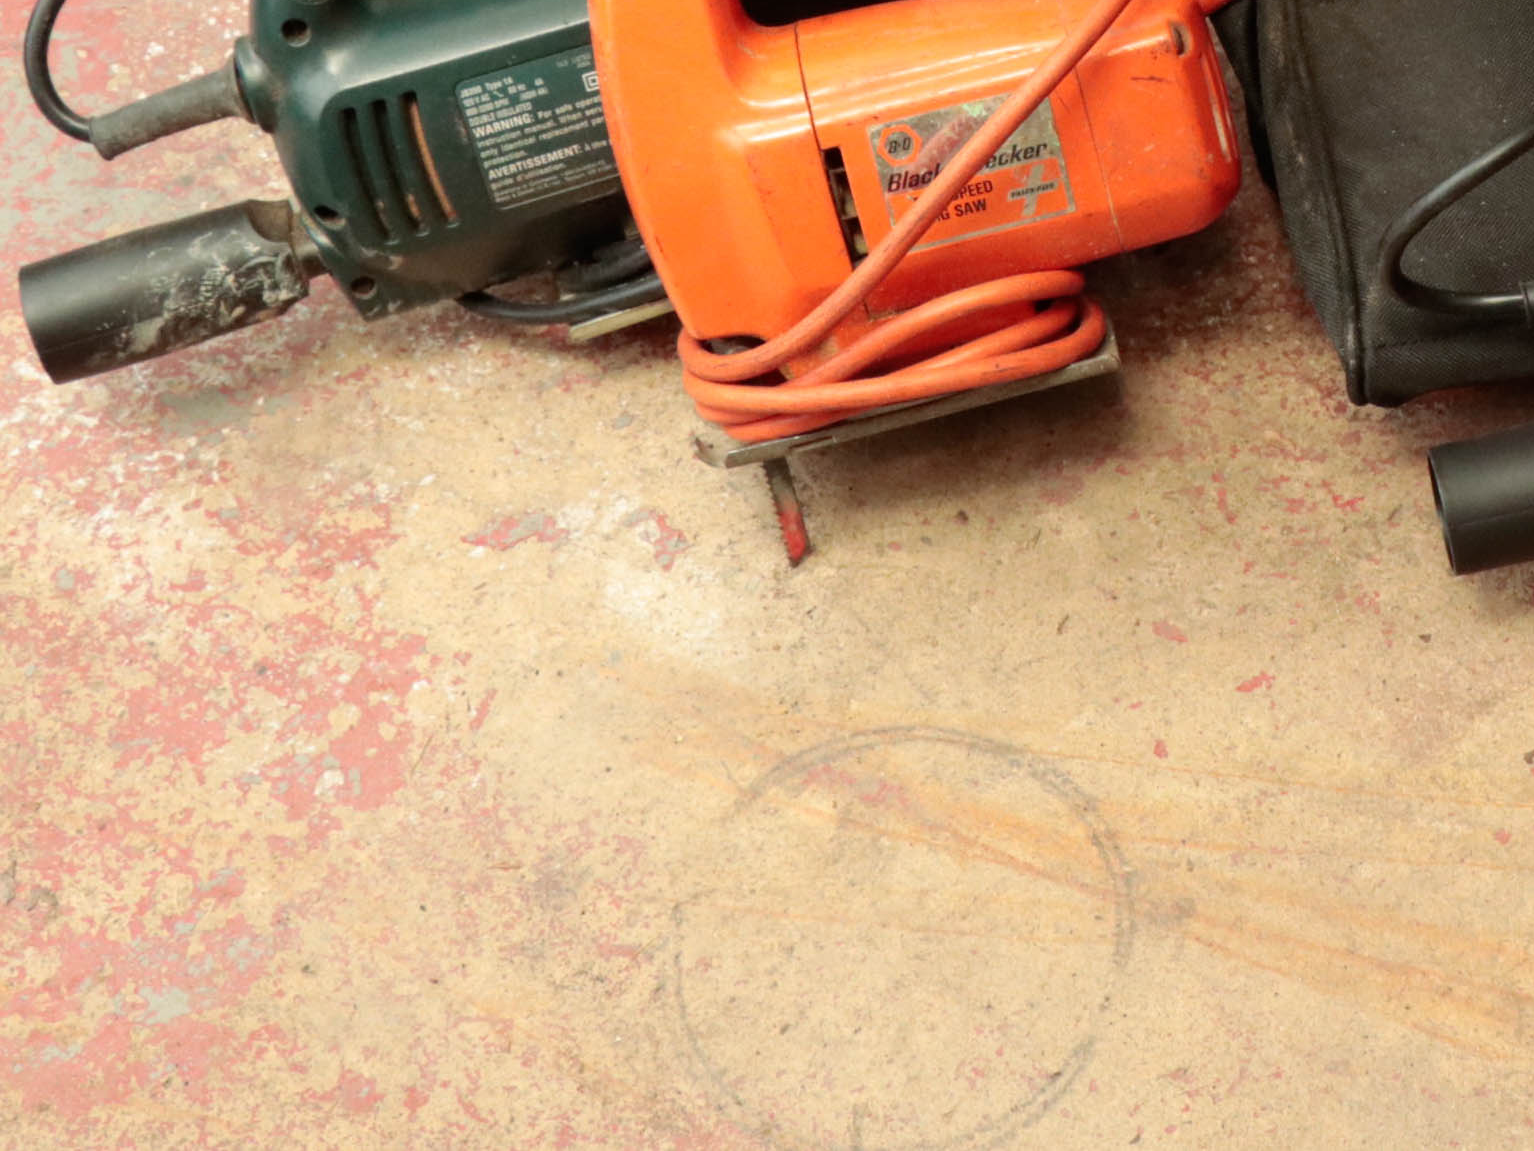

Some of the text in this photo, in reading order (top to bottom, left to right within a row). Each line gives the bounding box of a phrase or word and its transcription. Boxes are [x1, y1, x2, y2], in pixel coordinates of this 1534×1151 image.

[472, 113, 535, 138] WARNING:
[488, 144, 582, 180] AVERTISSEMENT:
[985, 143, 1047, 168] ecker
[954, 198, 986, 217] SAW
